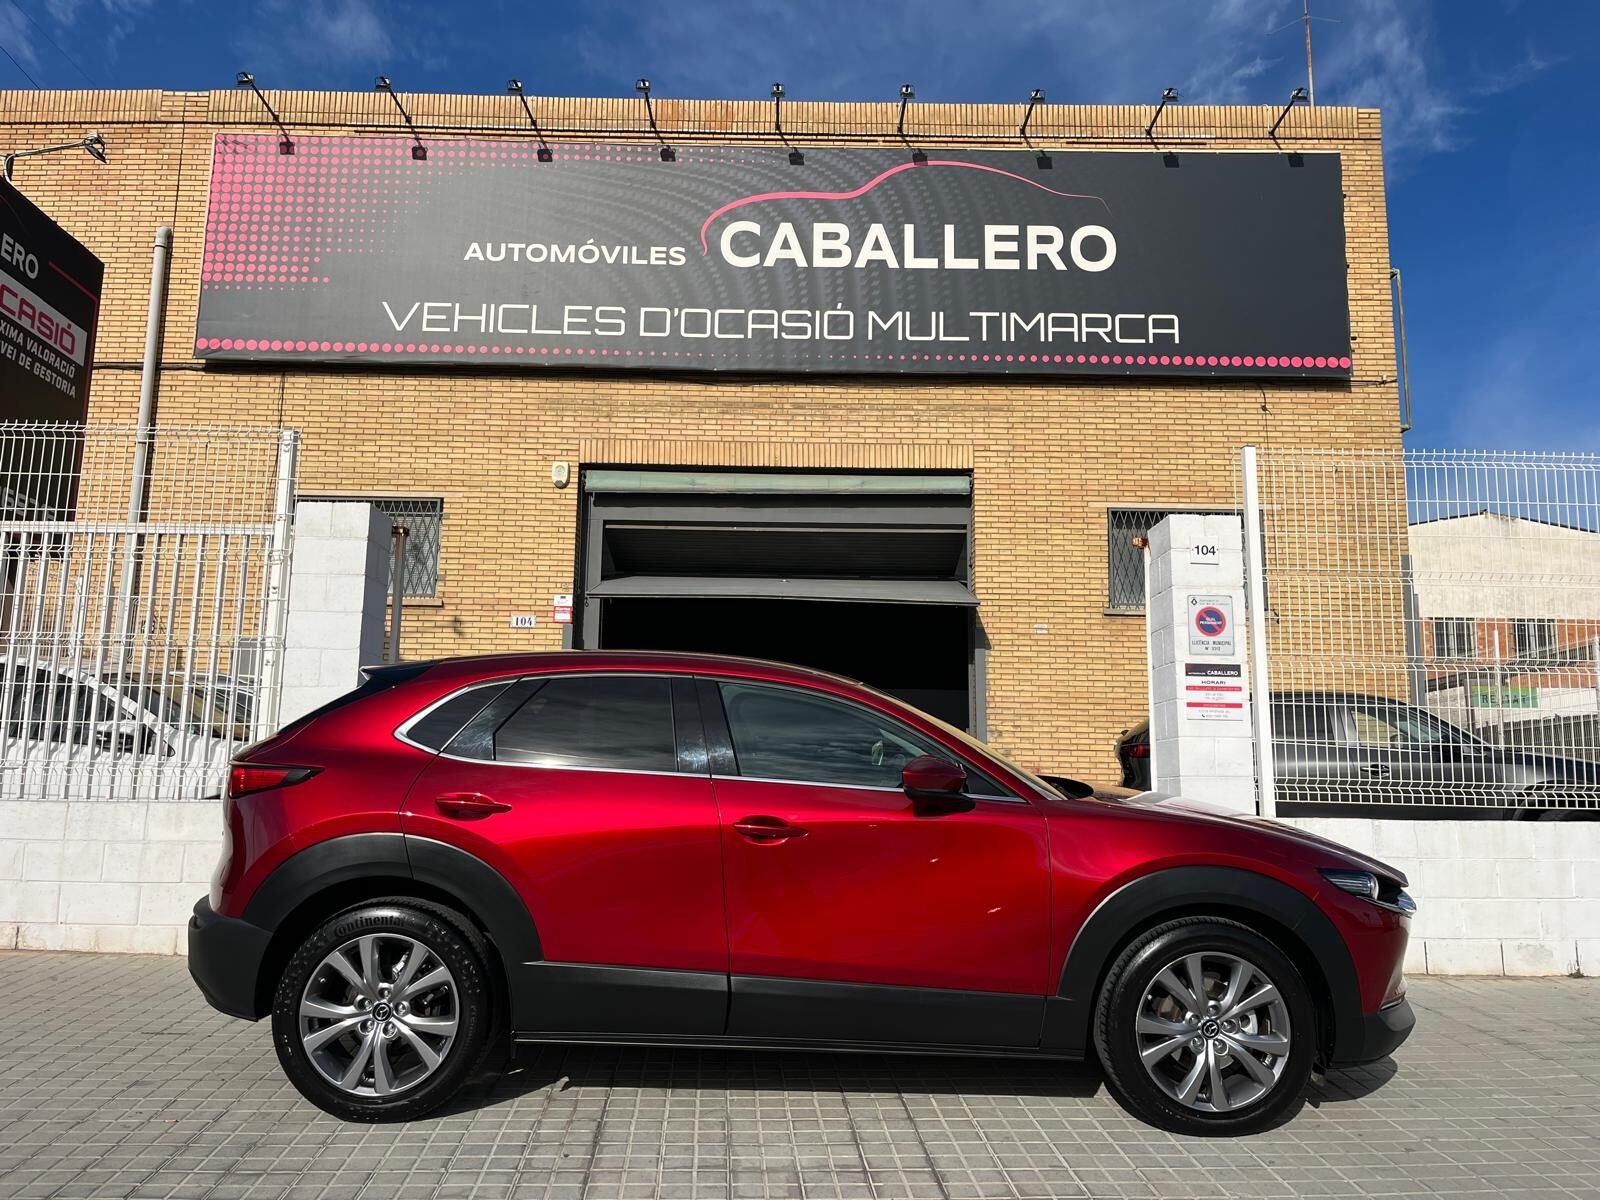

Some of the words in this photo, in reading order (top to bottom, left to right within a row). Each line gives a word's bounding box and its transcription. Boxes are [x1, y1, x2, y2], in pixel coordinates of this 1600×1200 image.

[0, 232, 39, 279] ERO
[463, 239, 687, 266] AUTOMÓVILES
[720, 220, 1118, 272] CABALLERO
[0, 284, 76, 356] CASIÓ
[382, 301, 626, 336] VEHICLES
[640, 303, 855, 341] D'OCASIÓ
[868, 311, 1180, 344] MULTIMARCA
[0, 319, 24, 346] XIMA
[26, 337, 76, 379] VALORACIÓ
[0, 340, 17, 361] VEI
[18, 352, 32, 370] DE
[33, 362, 76, 399] GESTORIA
[1194, 545, 1216, 556] 104
[515, 617, 533, 626] 104
[334, 915, 408, 937] Continental
